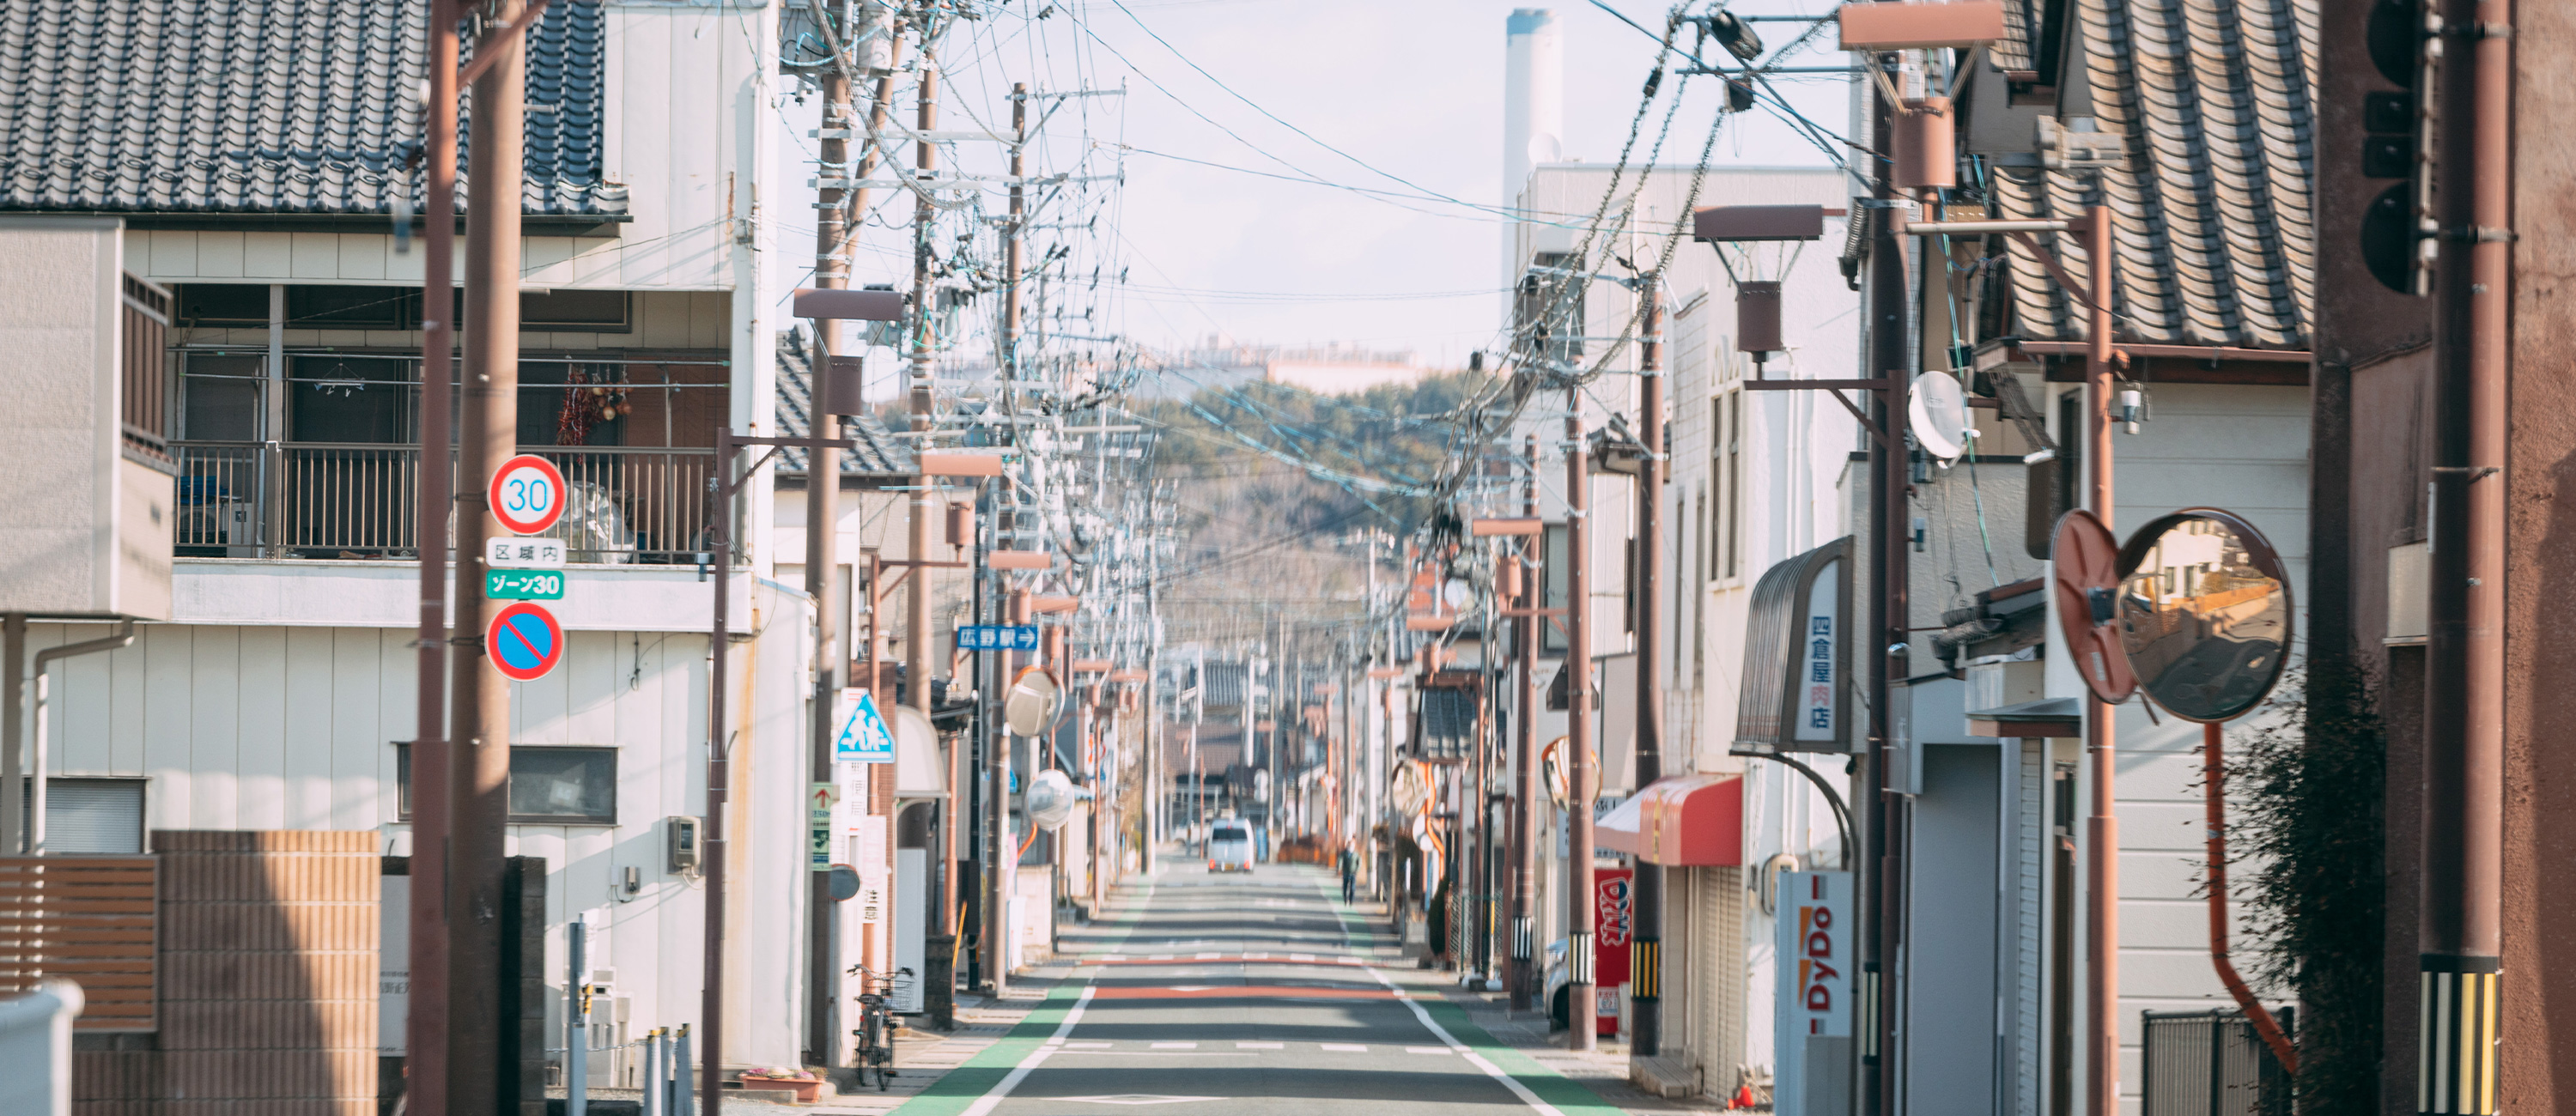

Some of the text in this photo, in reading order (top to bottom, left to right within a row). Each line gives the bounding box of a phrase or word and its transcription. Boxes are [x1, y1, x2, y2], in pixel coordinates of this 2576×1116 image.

[507, 478, 548, 513] 30
[495, 544, 557, 561] 区域内
[493, 575, 560, 594] ゾーン30
[959, 628, 1017, 647] 広野駅
[1810, 616, 1832, 729] 四倉屋肉店
[1807, 906, 1838, 1011] DyDo
